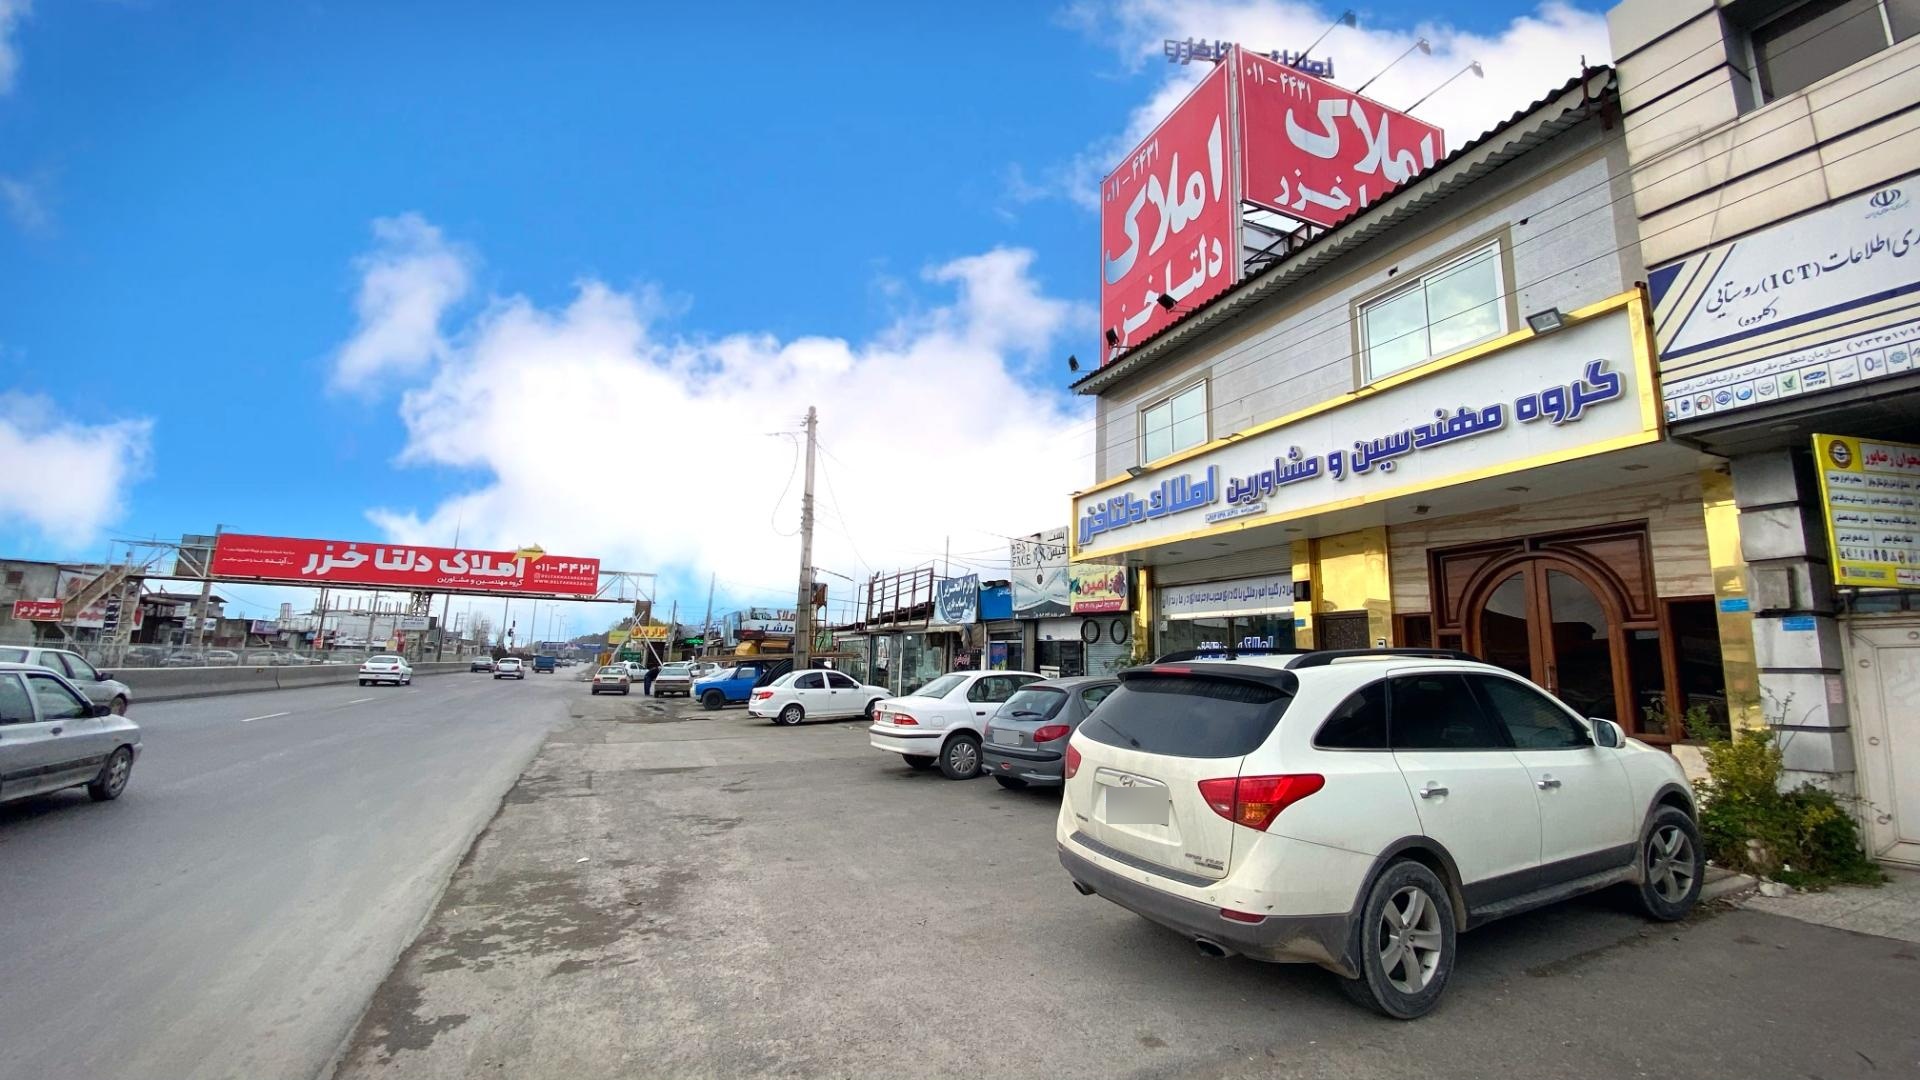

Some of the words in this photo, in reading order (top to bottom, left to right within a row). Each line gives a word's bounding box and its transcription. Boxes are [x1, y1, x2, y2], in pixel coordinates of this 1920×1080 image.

[1285, 98, 1435, 185] املاک
[1104, 113, 1224, 286] املاک
[1822, 232, 1891, 273] اطلاعات
[1514, 358, 1624, 426] گروه
[1351, 407, 1504, 474] مهندسین
[1226, 445, 1323, 506] مشاورین
[1327, 449, 1345, 480] و
[1146, 464, 1219, 520] املاک
[301, 543, 369, 576] خزر
[374, 548, 433, 573] دلتا
[439, 551, 526, 579] املاک
[436, 576, 470, 584] مشاورین
[475, 579, 508, 587] مهندسین
[508, 578, 525, 588] گروه
